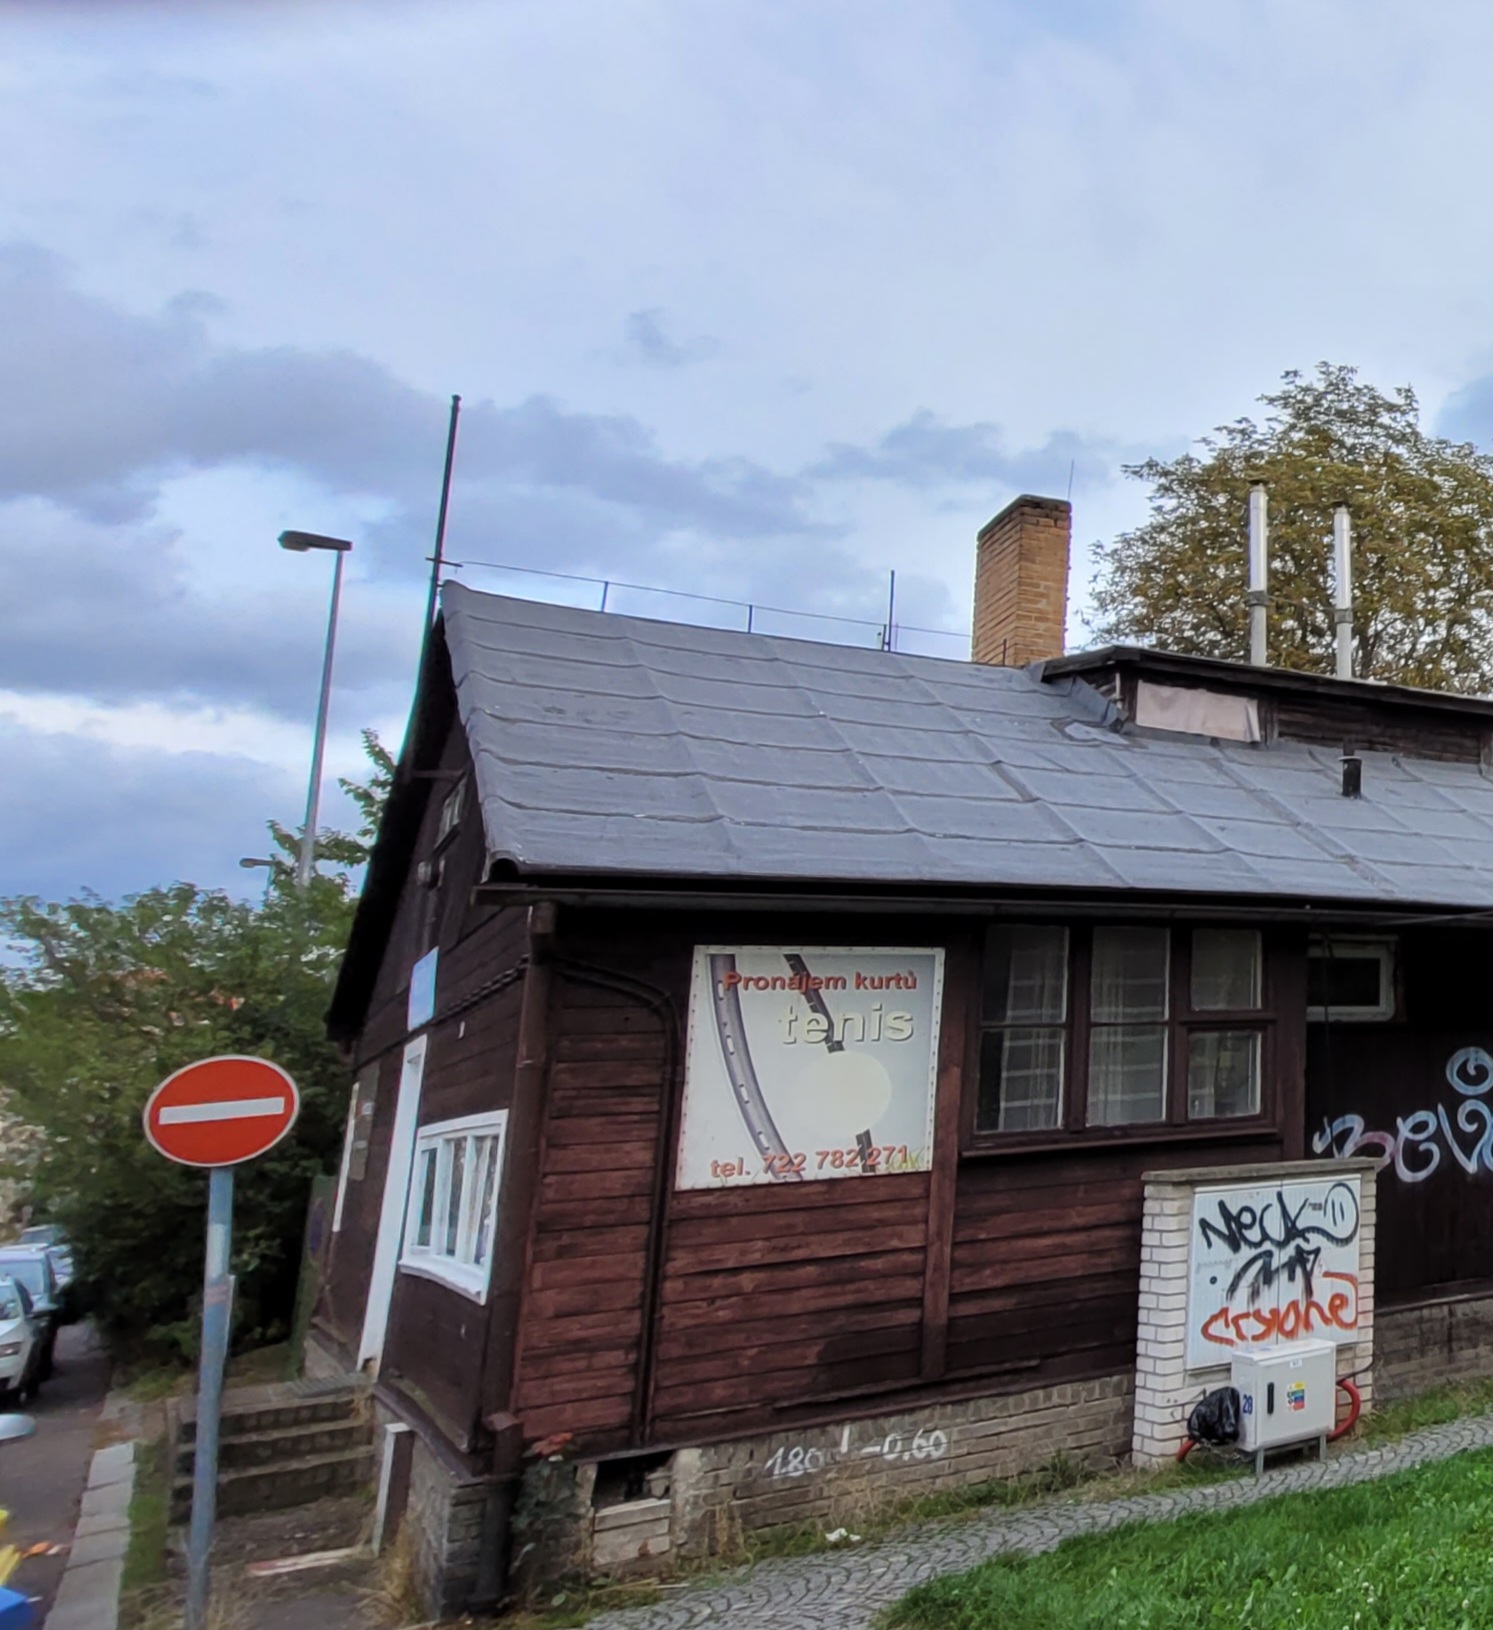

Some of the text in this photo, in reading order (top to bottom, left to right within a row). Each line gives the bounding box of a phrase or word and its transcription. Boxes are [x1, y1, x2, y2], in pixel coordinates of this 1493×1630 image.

[854, 969, 917, 991] kurtů
[780, 1003, 914, 1045] tenis
[709, 1144, 908, 1178] tel. 722 782 271
